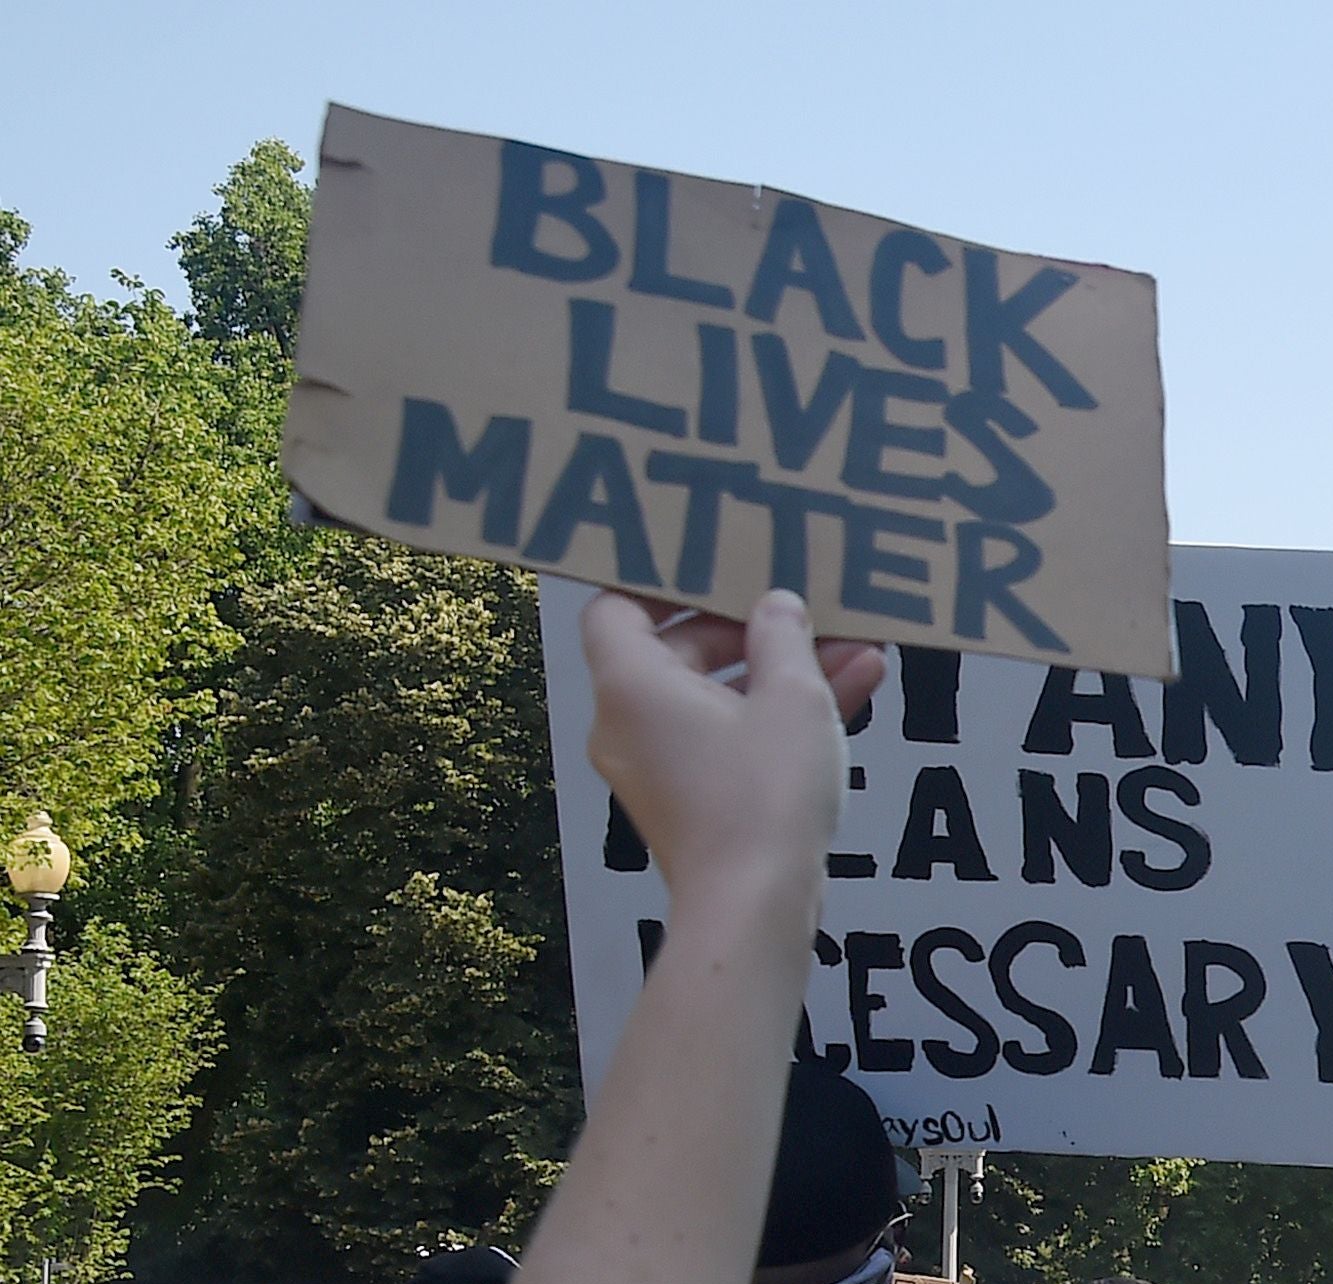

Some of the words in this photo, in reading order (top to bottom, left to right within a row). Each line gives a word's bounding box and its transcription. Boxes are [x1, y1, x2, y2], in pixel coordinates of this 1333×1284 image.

[490, 139, 1098, 412] BLACK
[385, 395, 1070, 653] MATTER
[567, 299, 1056, 526] LIVES
